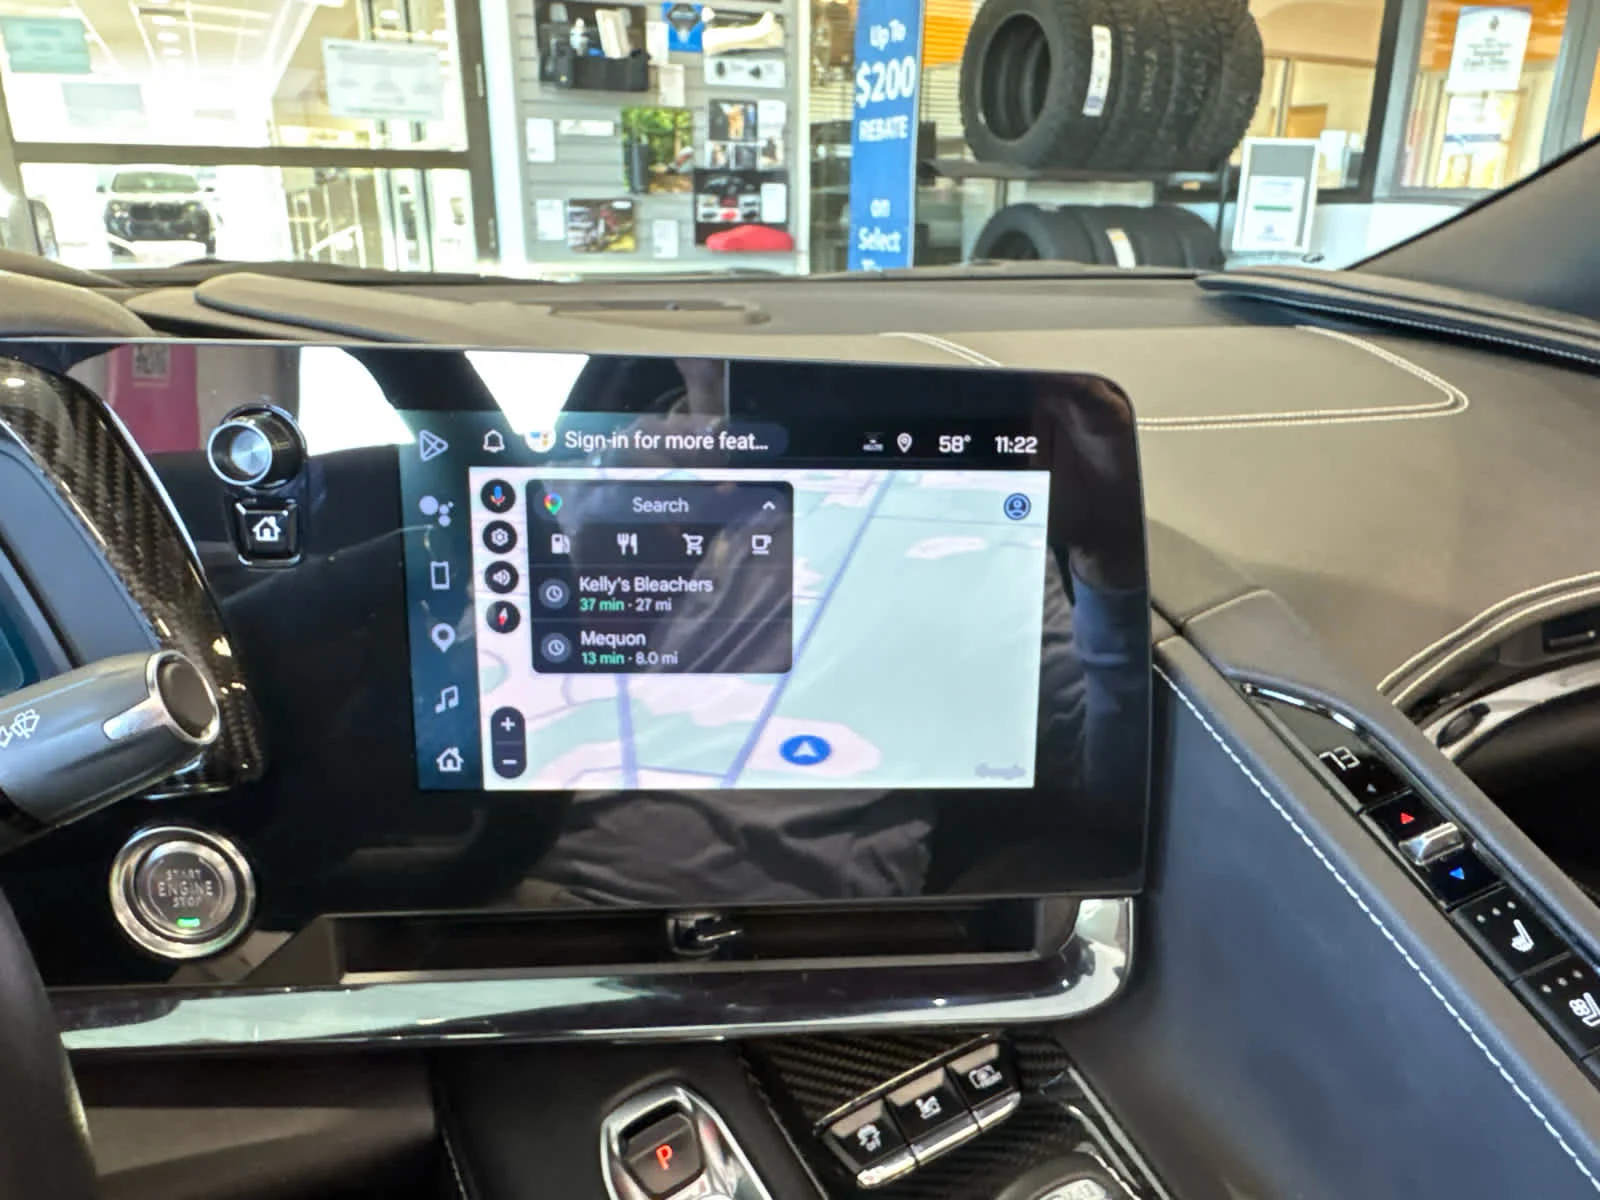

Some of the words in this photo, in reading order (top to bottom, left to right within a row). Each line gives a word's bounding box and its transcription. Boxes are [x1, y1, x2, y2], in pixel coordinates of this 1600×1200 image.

[869, 24, 889, 51] Up
[888, 19, 906, 42] To
[856, 55, 915, 108] $200
[859, 114, 908, 142] REBATE
[858, 226, 901, 252] Select
[564, 430, 628, 452] Sign-in
[634, 430, 660, 449] for
[665, 433, 714, 449] more
[718, 431, 769, 450] feat...
[938, 434, 972, 453] 58°
[995, 435, 1038, 454] 11:22
[631, 497, 690, 514] Search
[579, 575, 631, 596] Kelly's
[633, 576, 714, 593] Bleachers
[579, 597, 597, 612] 37
[599, 597, 625, 611] min
[635, 597, 652, 612] 27
[654, 597, 673, 612] mi
[580, 630, 647, 649] Mequon
[581, 652, 597, 665] 13
[599, 651, 625, 665] min
[635, 651, 659, 665] 8.0
[661, 651, 679, 665] mi
[165, 869, 202, 881] START
[158, 880, 214, 897] ENGINE
[172, 897, 202, 909] STOP
[655, 1143, 673, 1170] P
